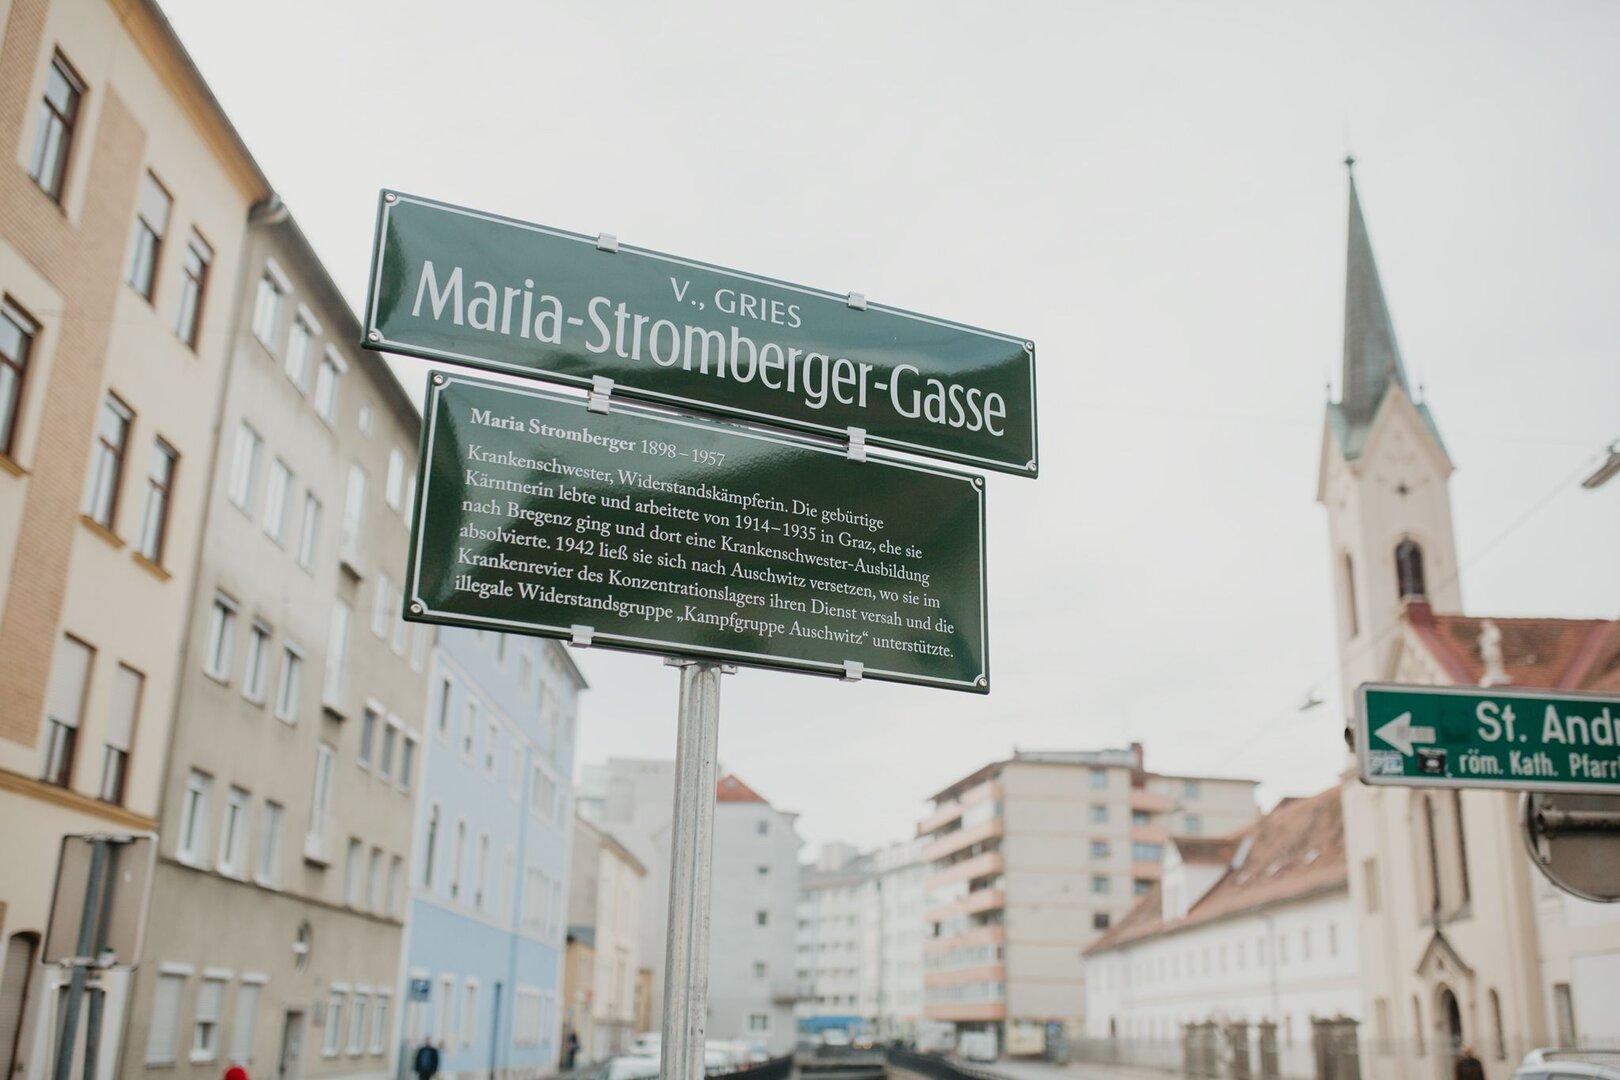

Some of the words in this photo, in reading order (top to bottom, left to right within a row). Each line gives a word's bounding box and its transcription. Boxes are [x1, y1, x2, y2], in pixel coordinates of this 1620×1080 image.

[670, 277, 705, 311] V.,
[714, 288, 801, 328] GRIES
[411, 260, 1006, 437] Maria-Stromberger-Gasse
[470, 407, 525, 432] Maria
[529, 418, 636, 453] Stromberger
[465, 469, 554, 498] Kärntnerin
[558, 484, 596, 505] lebte
[601, 495, 631, 510] und
[635, 499, 699, 521] arbeitete
[703, 513, 730, 527] von
[821, 529, 834, 544] in
[838, 532, 876, 554] Graz,
[879, 539, 902, 555] ehe
[905, 545, 922, 559] sie
[467, 444, 614, 485] Krankenschwester,
[617, 469, 788, 512] Widerstandskämpferin.
[792, 499, 817, 517] Die
[821, 508, 884, 532] gebürtige
[460, 522, 551, 549] absolvierte.
[556, 536, 594, 556] 1942
[598, 542, 628, 561] ließ
[632, 549, 653, 564] sie
[657, 552, 687, 569] sich
[691, 559, 726, 576] nach
[730, 562, 806, 588] Auschwitz
[809, 579, 876, 600] versetzen,
[879, 590, 899, 601] wo
[903, 591, 919, 605] sie
[924, 593, 940, 608] im
[462, 499, 501, 515] nach
[506, 501, 572, 527] Bregenz
[575, 515, 611, 537] ging
[615, 522, 645, 538] und
[649, 525, 682, 543] dort
[686, 532, 716, 549] eine
[721, 535, 930, 587] Krankenschwester-Ausbildung
[454, 575, 513, 599] illegale
[517, 582, 673, 622] Widerstandsgruppe
[873, 637, 954, 658] unterstützte.
[458, 547, 574, 578] Krankenrevier
[577, 565, 603, 583] des
[608, 569, 765, 608] Konzentrationslagers
[770, 593, 806, 612] ihren
[811, 598, 857, 619] Dienst
[860, 611, 902, 626] versah
[906, 616, 931, 630] und
[935, 618, 954, 634] die
[1459, 748, 1504, 775] röm.
[1509, 749, 1559, 777] Kath.
[1568, 752, 1620, 779] Pfarr
[1476, 700, 1527, 742] St.
